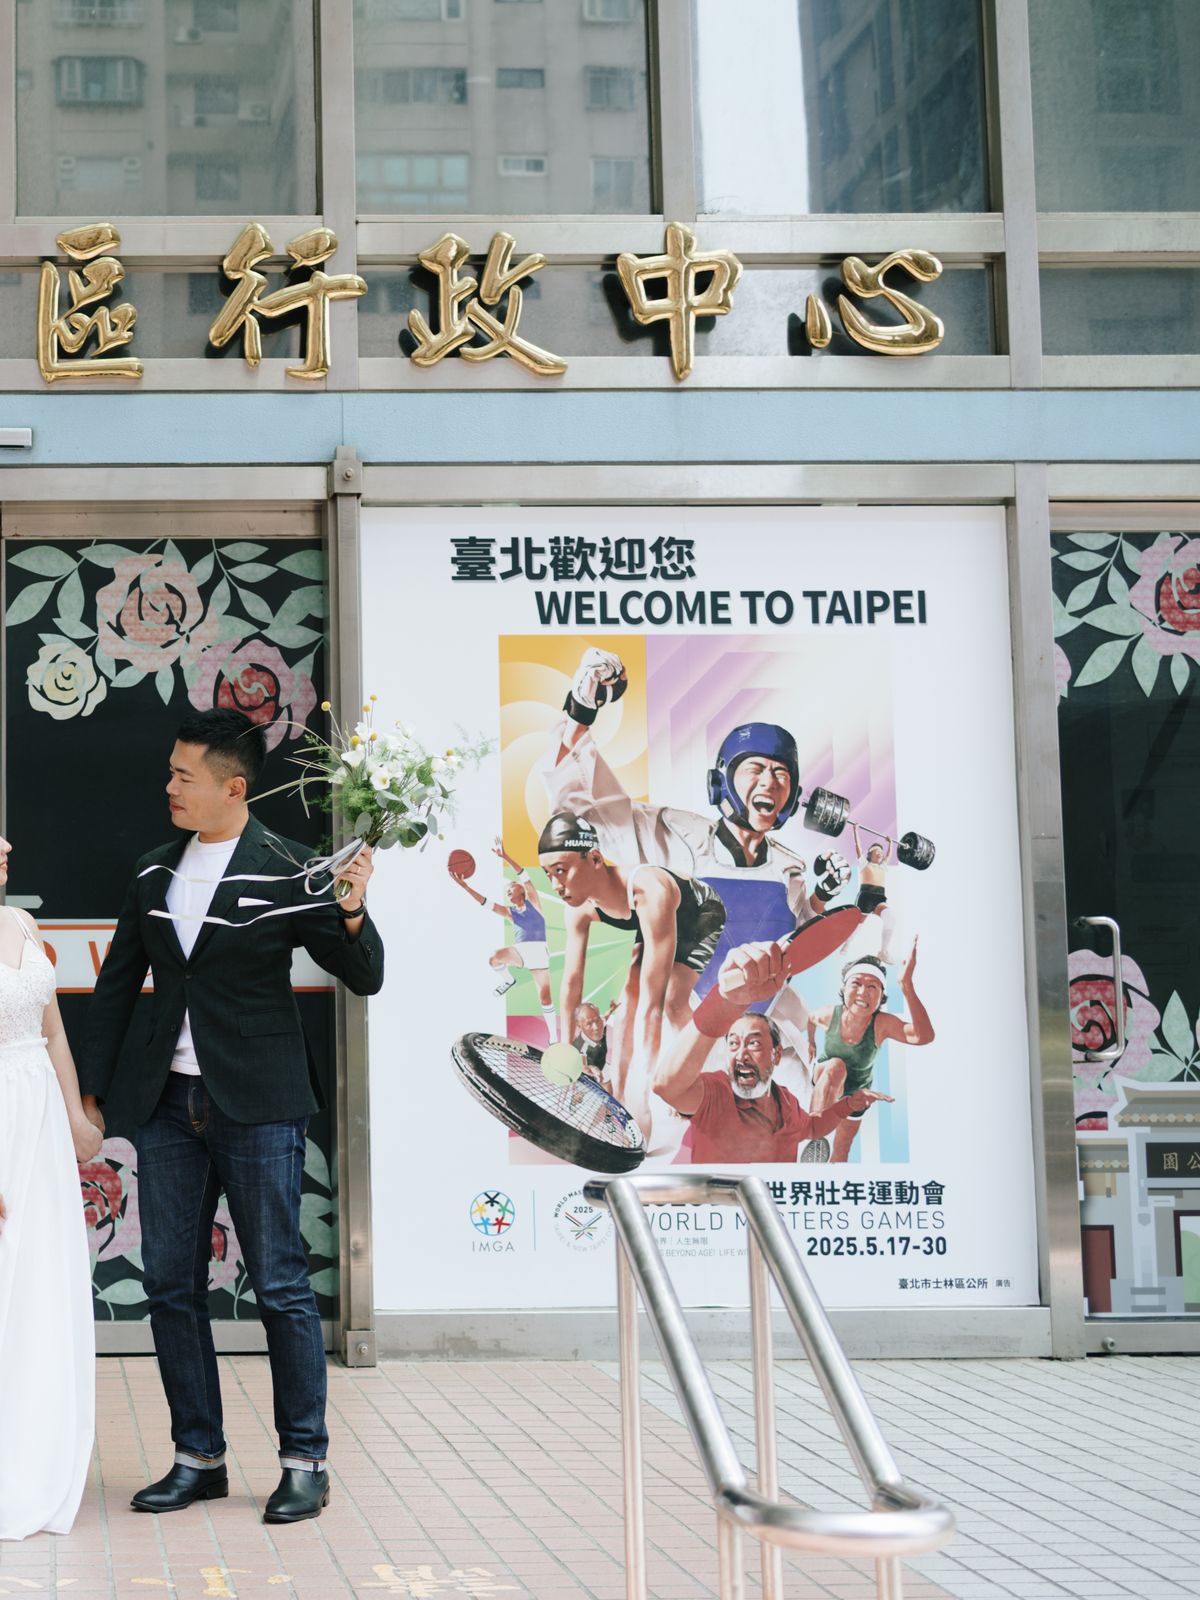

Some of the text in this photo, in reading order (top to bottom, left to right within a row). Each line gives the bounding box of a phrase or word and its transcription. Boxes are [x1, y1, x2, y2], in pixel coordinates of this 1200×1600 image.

[450, 536, 697, 582] 臺北歡迎您
[535, 590, 927, 625] WELCOME TO TAIPEI
[736, 1210, 850, 1231] MTERS
[861, 1210, 945, 1230] GAMES
[472, 1241, 515, 1252] IMGA
[807, 1236, 947, 1256] 2025.5.17-30
[898, 1278, 988, 1290] 臺北市士林區公所
